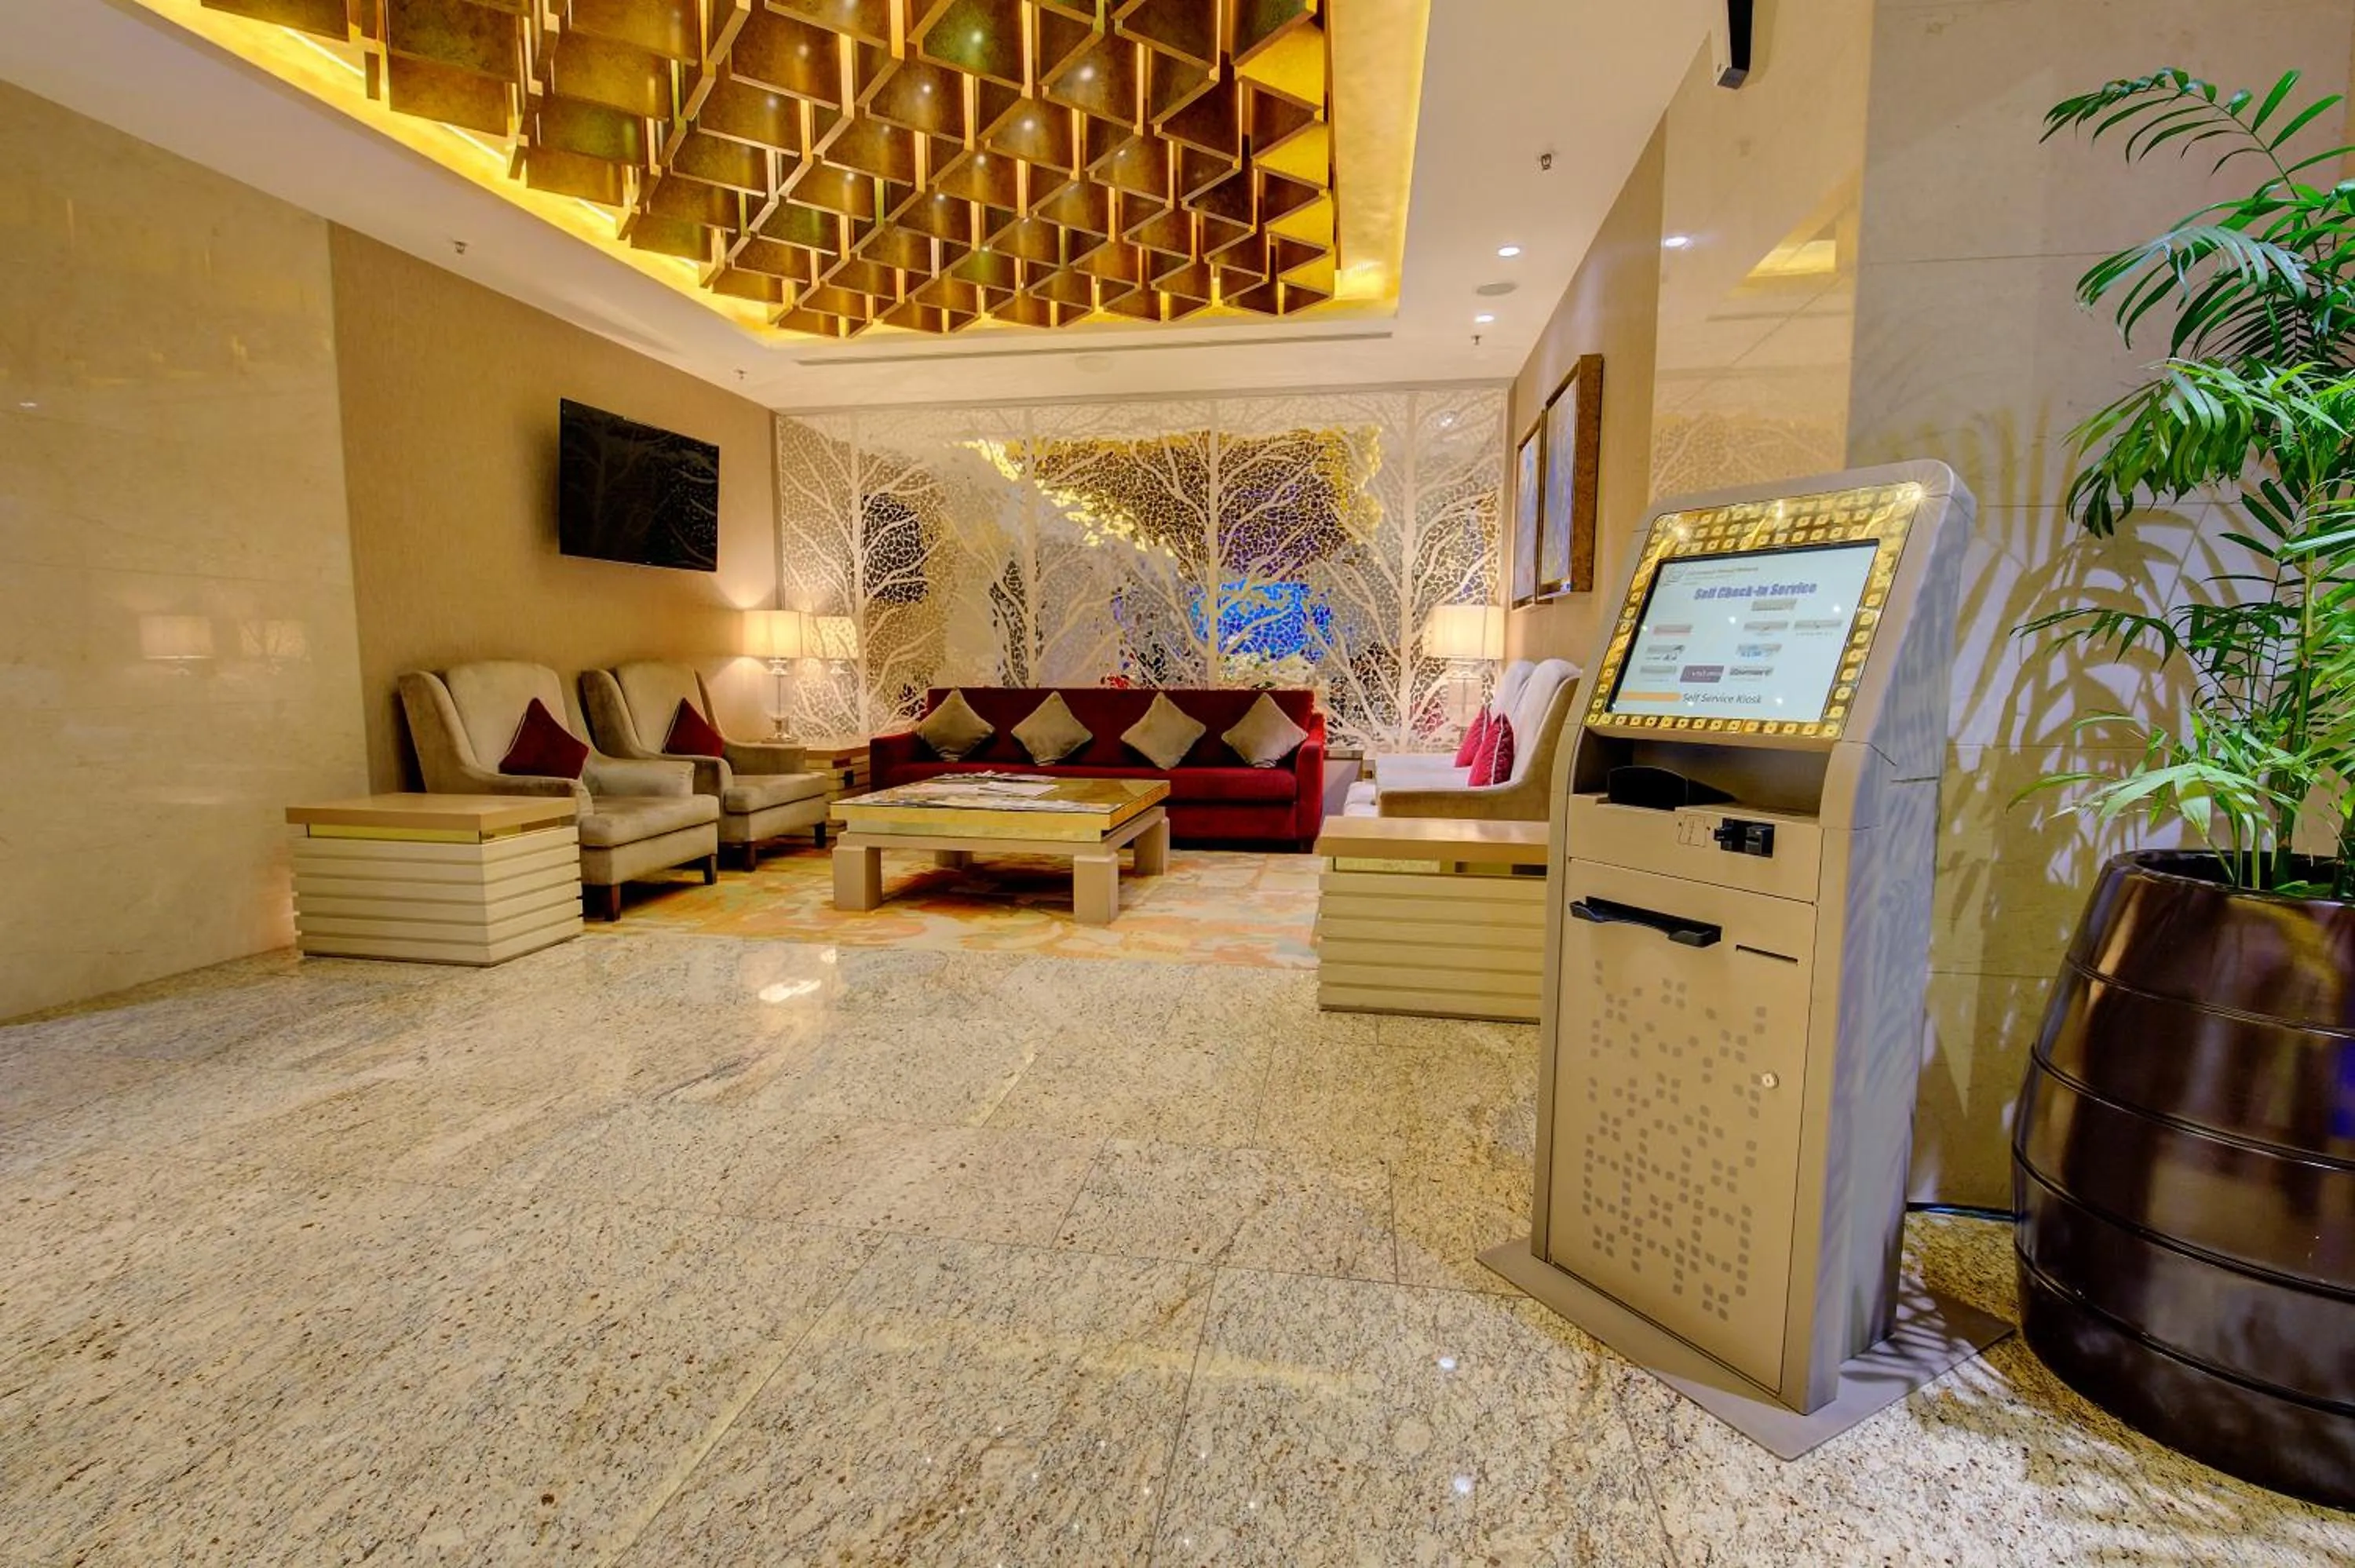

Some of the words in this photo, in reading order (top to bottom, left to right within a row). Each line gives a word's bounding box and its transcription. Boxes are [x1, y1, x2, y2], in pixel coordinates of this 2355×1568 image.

[1693, 587, 1716, 600] Self
[1769, 582, 1817, 596] Service
[1682, 691, 1702, 703] Self
[1700, 691, 1735, 703] Service
[1735, 694, 1762, 704] Kiosk
